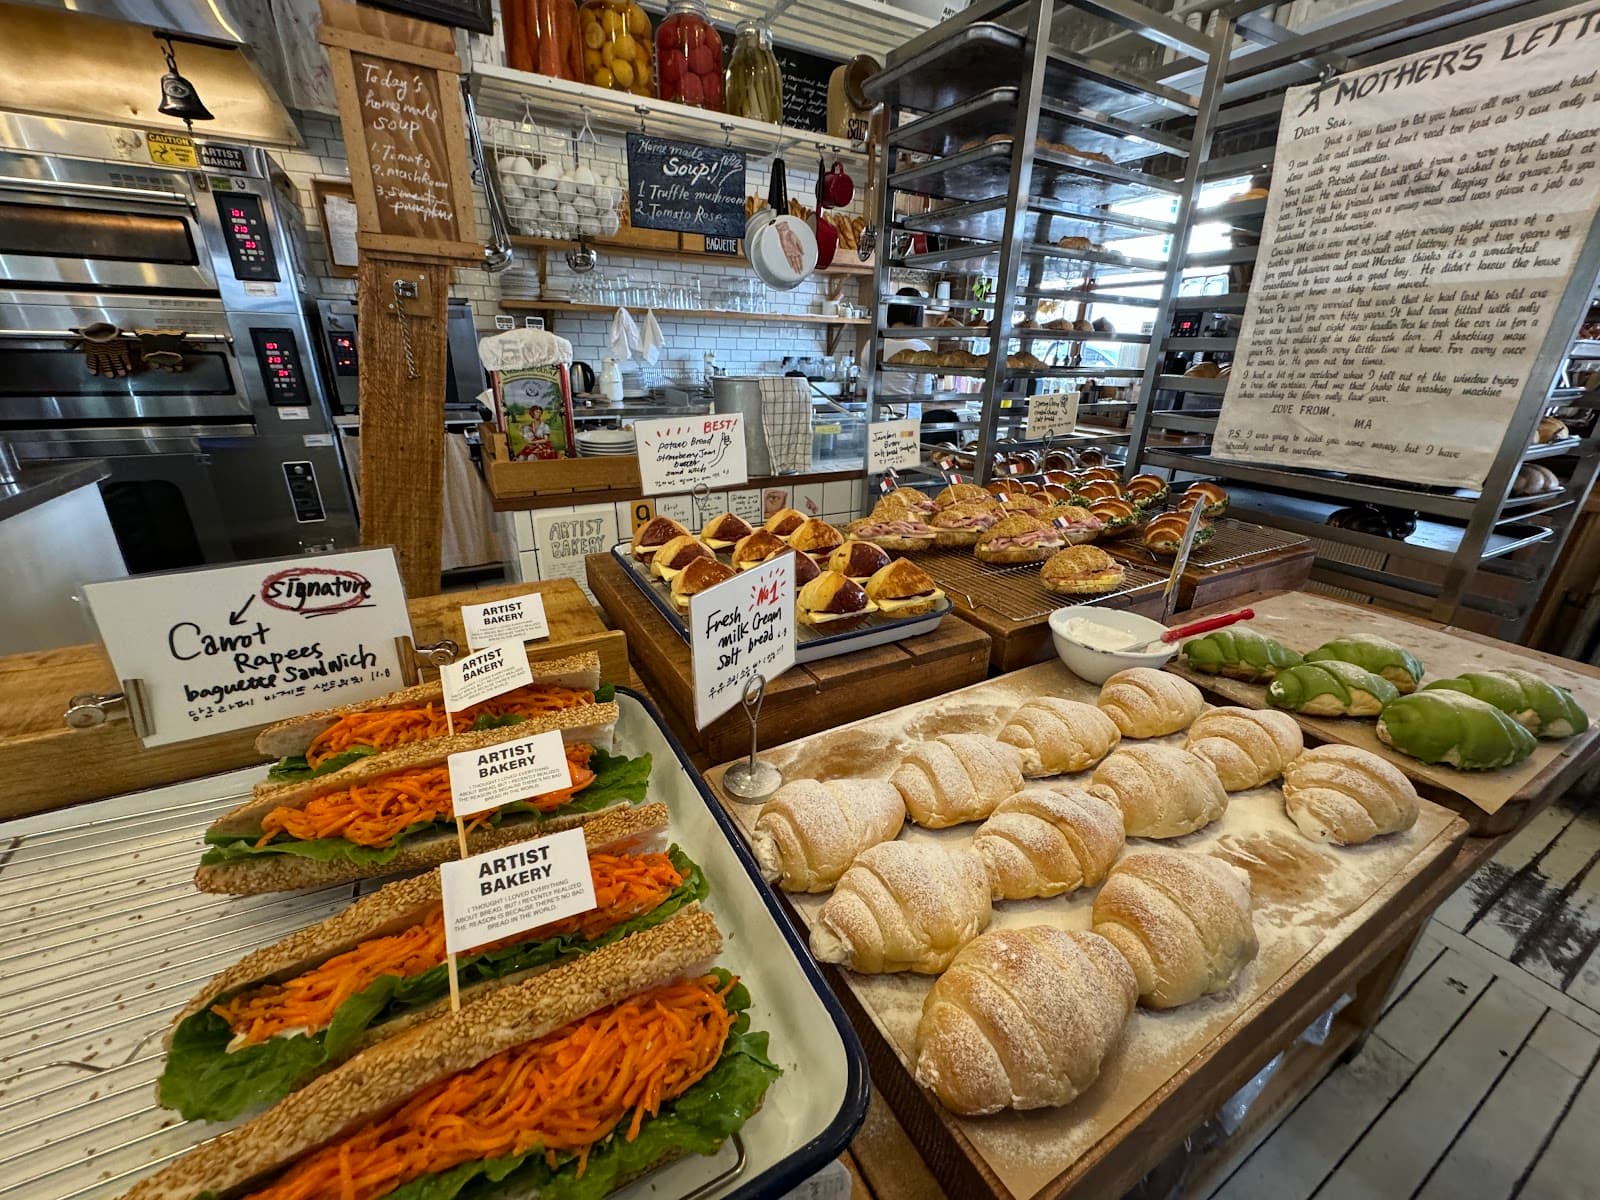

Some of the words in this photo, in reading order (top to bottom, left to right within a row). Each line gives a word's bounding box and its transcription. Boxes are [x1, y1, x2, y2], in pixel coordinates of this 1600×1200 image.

[1334, 43, 1487, 105] MOTHER'S
[1500, 9, 1600, 61] LETT
[362, 63, 422, 101] Today's
[149, 132, 190, 146] CAUTION
[1294, 126, 1319, 140] Dear
[201, 145, 241, 159] ARTIST
[203, 156, 242, 169] BAKERY
[382, 144, 431, 168] Tomato
[663, 157, 718, 186] Soup!
[649, 184, 690, 200] Truffle
[649, 203, 692, 220] Tomato
[706, 237, 736, 252] BAGUETTE
[1421, 263, 1435, 275] He
[1271, 404, 1293, 414] LOVE
[704, 418, 738, 435] BEST!
[1354, 419, 1372, 429] MA
[549, 518, 603, 540] ARTIST
[551, 534, 606, 559] BAKERY
[482, 602, 522, 617] ARTIST
[483, 611, 524, 625] BAKERY
[705, 606, 741, 639] Fresh
[718, 621, 749, 648] milk
[748, 623, 774, 654] bread
[234, 642, 323, 673] Rapees
[462, 648, 502, 673] ARTIST
[463, 658, 504, 682] BAKERY
[184, 674, 277, 704] baguette
[477, 742, 534, 766] ARTIST
[479, 755, 536, 779] BAKERY
[478, 845, 550, 879] ARTIST
[480, 864, 552, 896] BAKERY
[456, 913, 478, 924] ABOUT
[504, 902, 517, 911] BUT
[522, 890, 551, 904] RECENTLY
[552, 882, 582, 897] REALIZED
[472, 900, 503, 912] THOUGHT
[508, 890, 530, 902] LOVED
[530, 878, 569, 895] EVERYTHING
[454, 924, 467, 932] THE
[470, 915, 496, 928] REASON
[505, 904, 533, 916] BECAUSE
[536, 895, 560, 909] THERE'S
[571, 888, 585, 897] BAD
[487, 918, 509, 930] BREAD
[520, 913, 531, 921] THE
